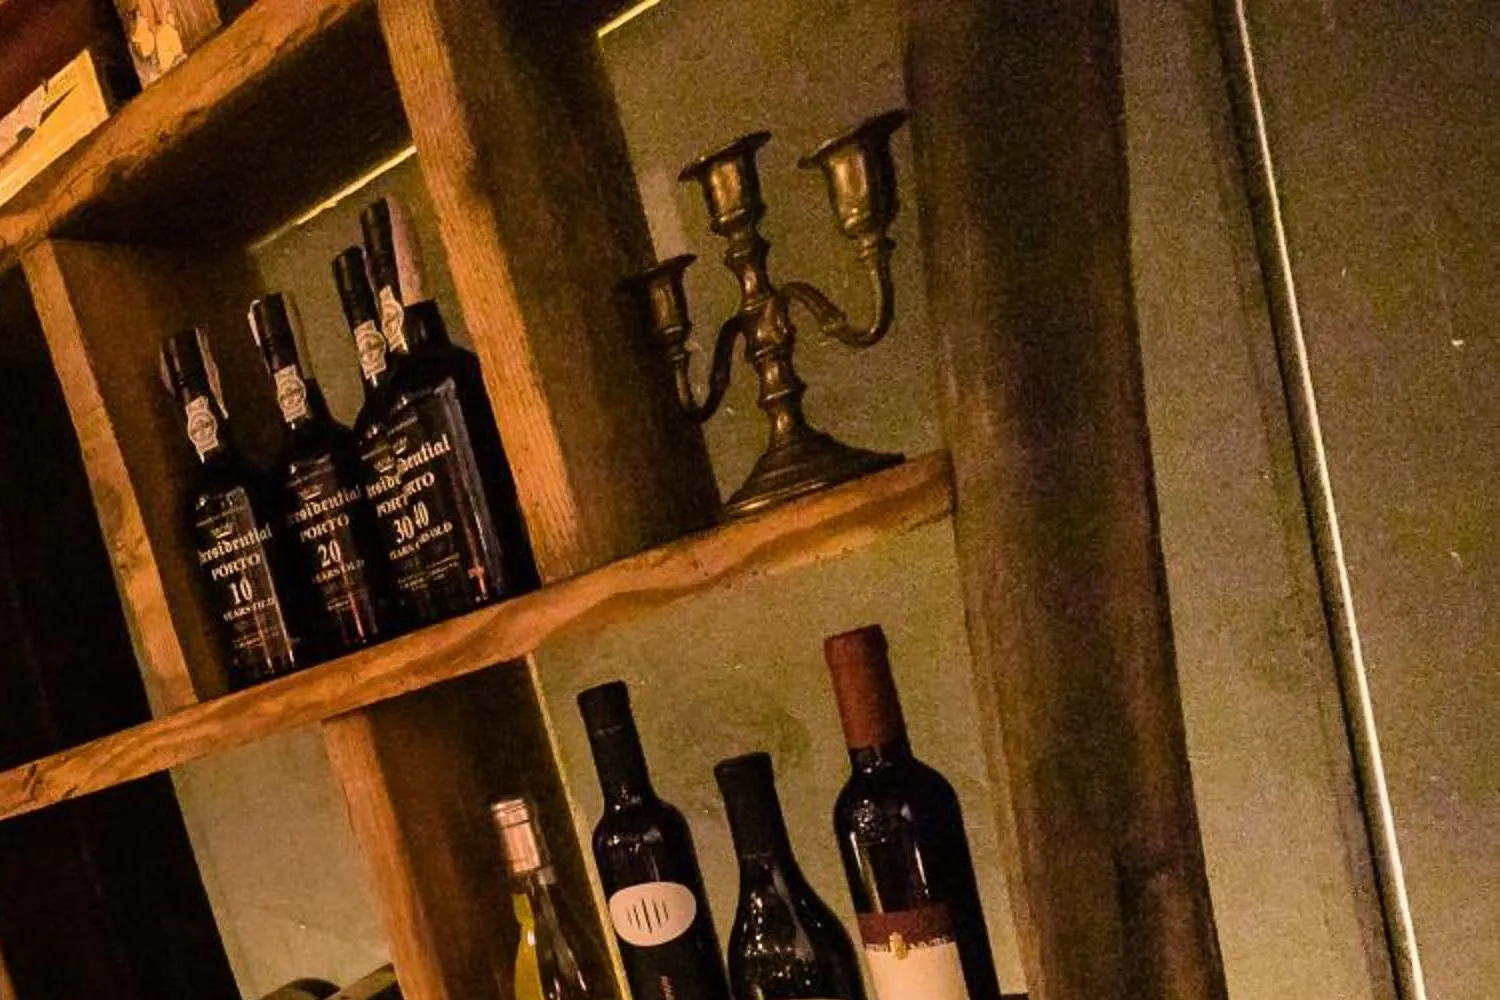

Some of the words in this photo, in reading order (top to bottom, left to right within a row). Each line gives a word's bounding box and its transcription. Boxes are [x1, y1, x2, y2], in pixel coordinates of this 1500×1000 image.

[393, 515, 415, 543] 30
[211, 552, 261, 581] PORTO
[317, 538, 341, 568] 20
[229, 576, 253, 604] 10
